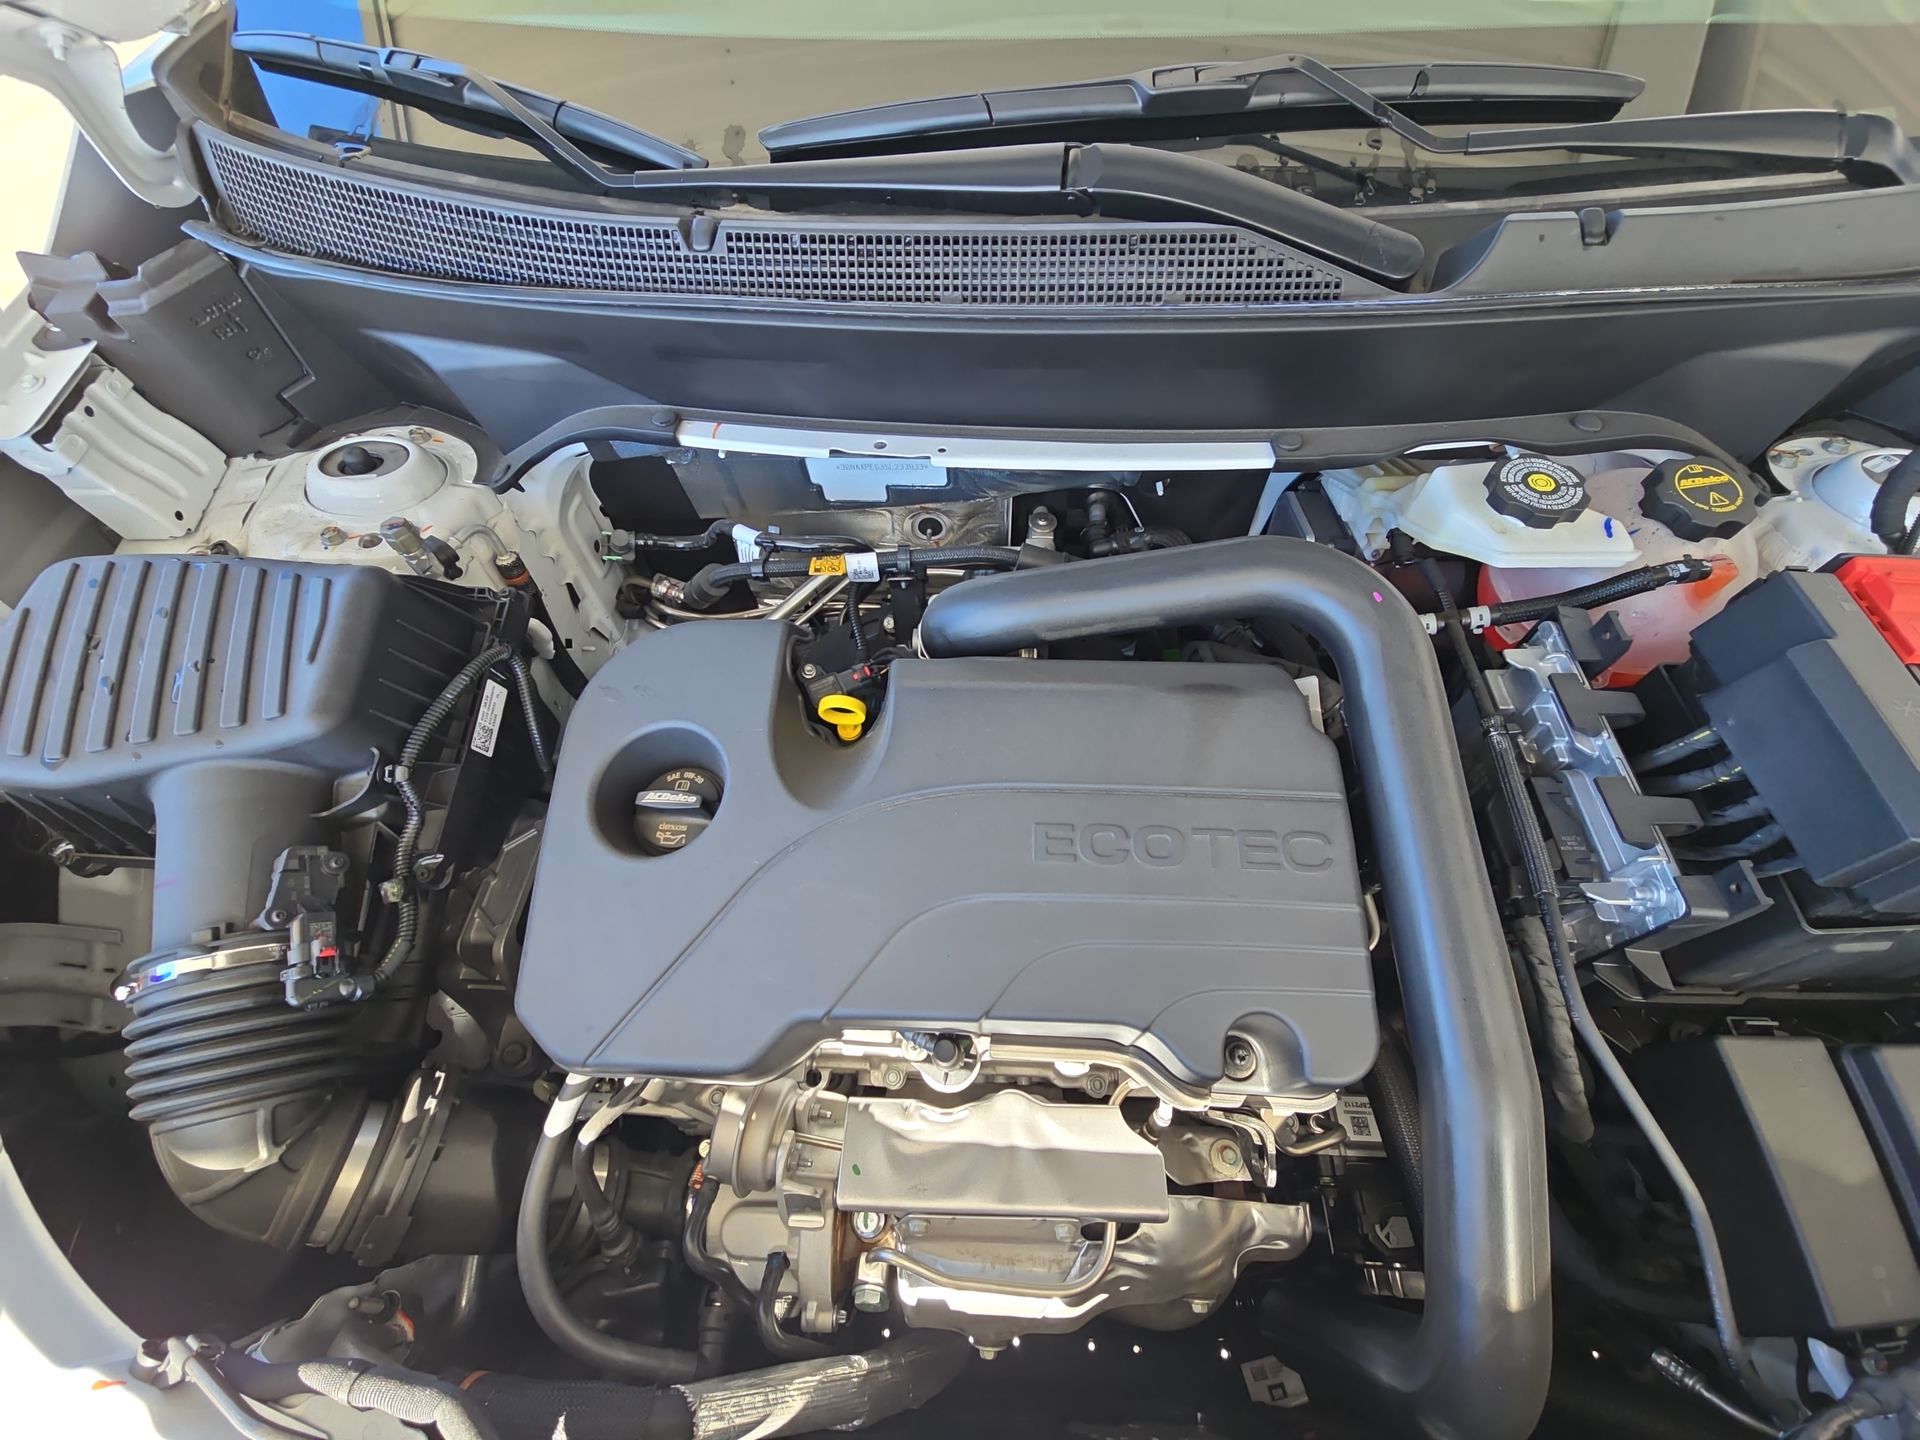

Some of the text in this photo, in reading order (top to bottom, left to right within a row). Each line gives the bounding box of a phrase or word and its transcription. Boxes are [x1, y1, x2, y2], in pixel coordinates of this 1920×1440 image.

[666, 772, 681, 782] SAE
[644, 792, 697, 803] ACDelco
[658, 822, 688, 831] dexos
[1032, 821, 1334, 875] ECOTEC
